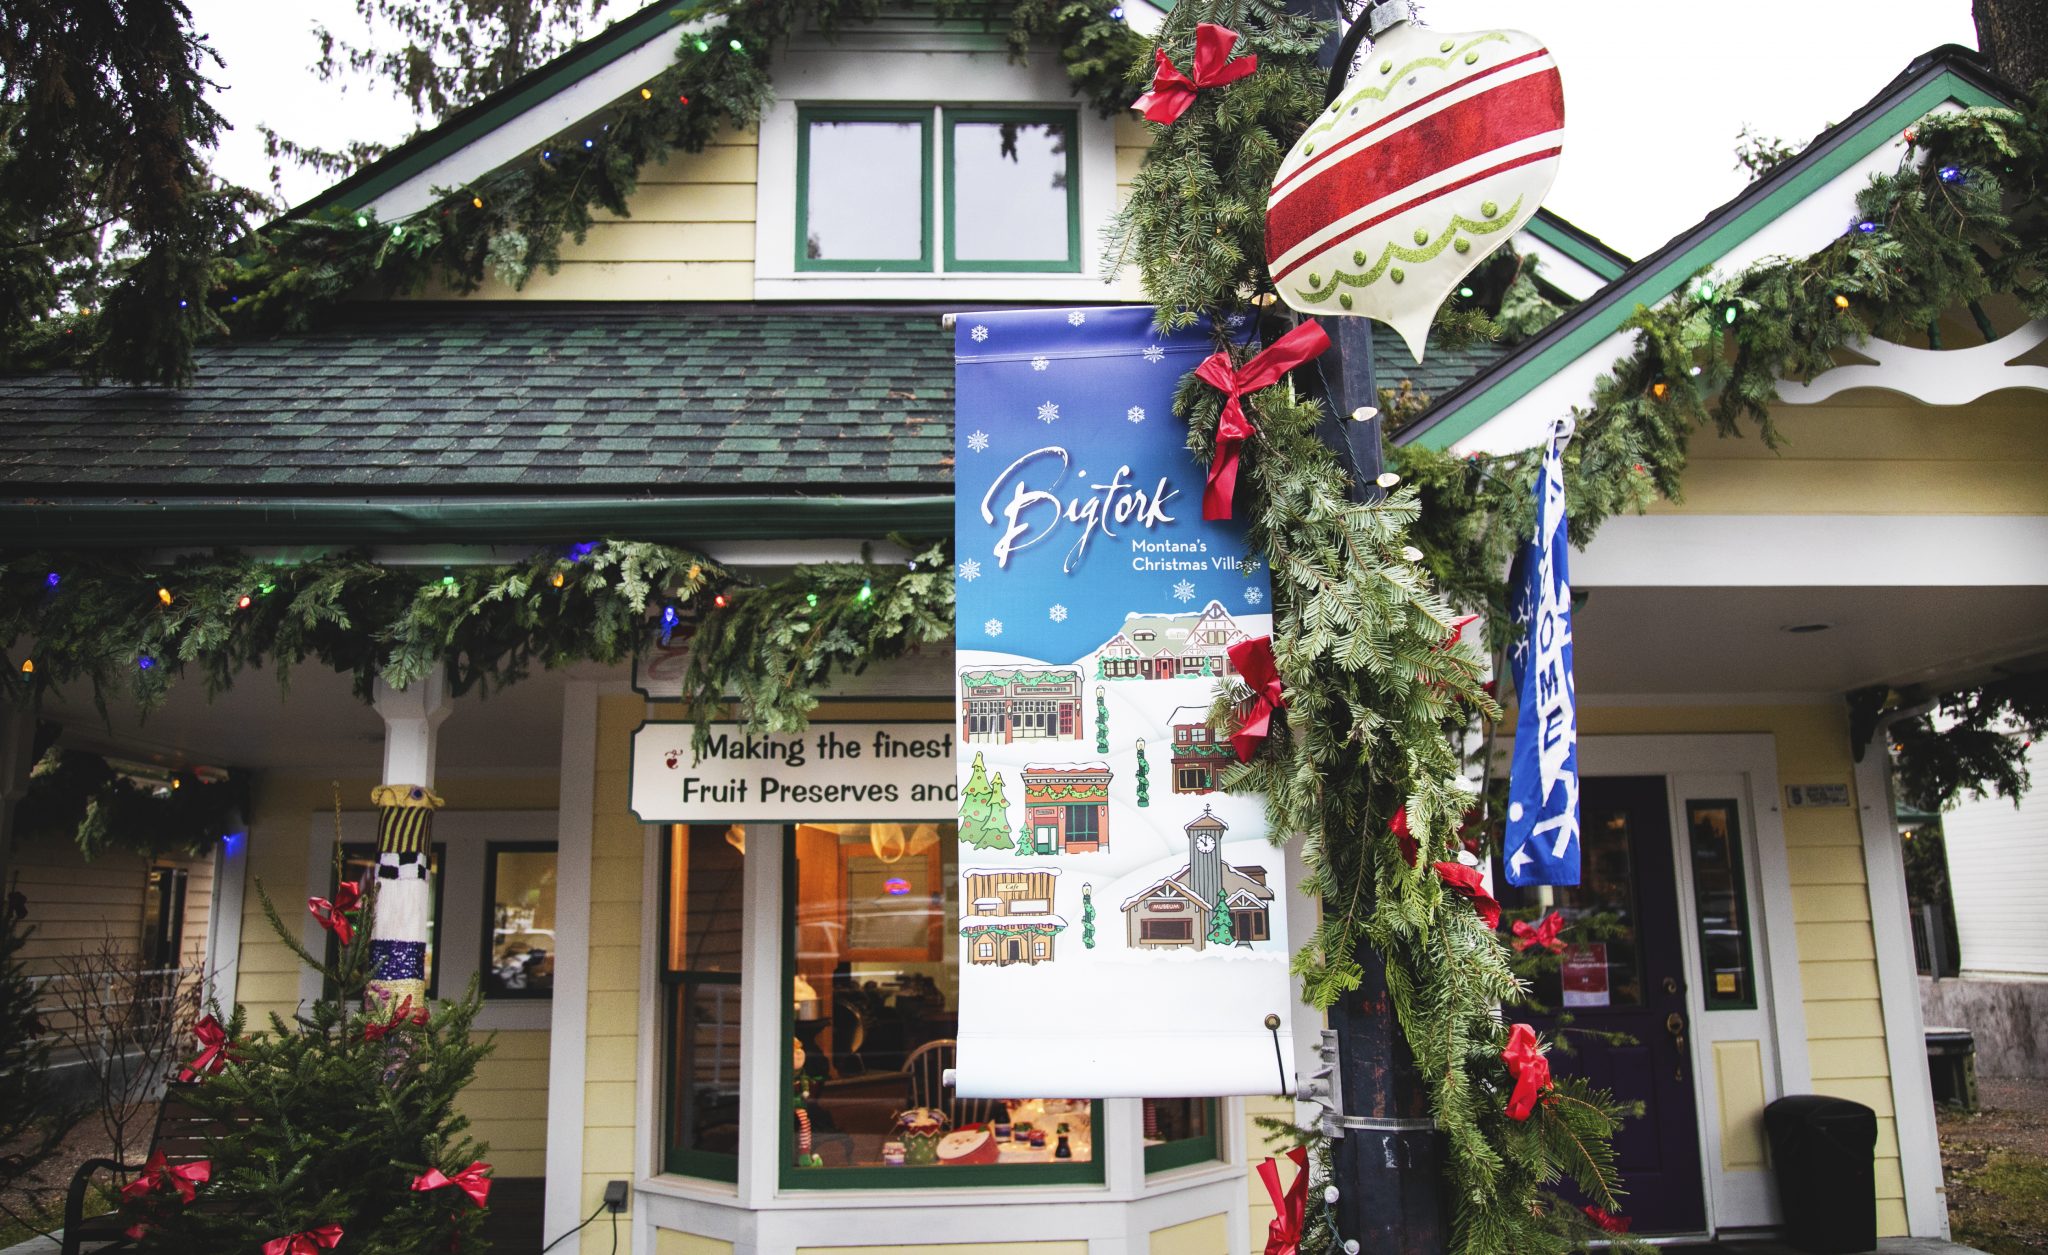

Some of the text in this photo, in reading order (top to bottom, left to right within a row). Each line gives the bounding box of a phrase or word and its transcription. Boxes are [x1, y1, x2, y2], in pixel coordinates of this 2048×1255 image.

[980, 446, 1179, 573] Bigfork
[1132, 539, 1207, 553] Montana's
[1132, 556, 1208, 571] Christmas
[702, 731, 953, 767] Making the finest
[682, 774, 958, 803] Fruit Preserves and
